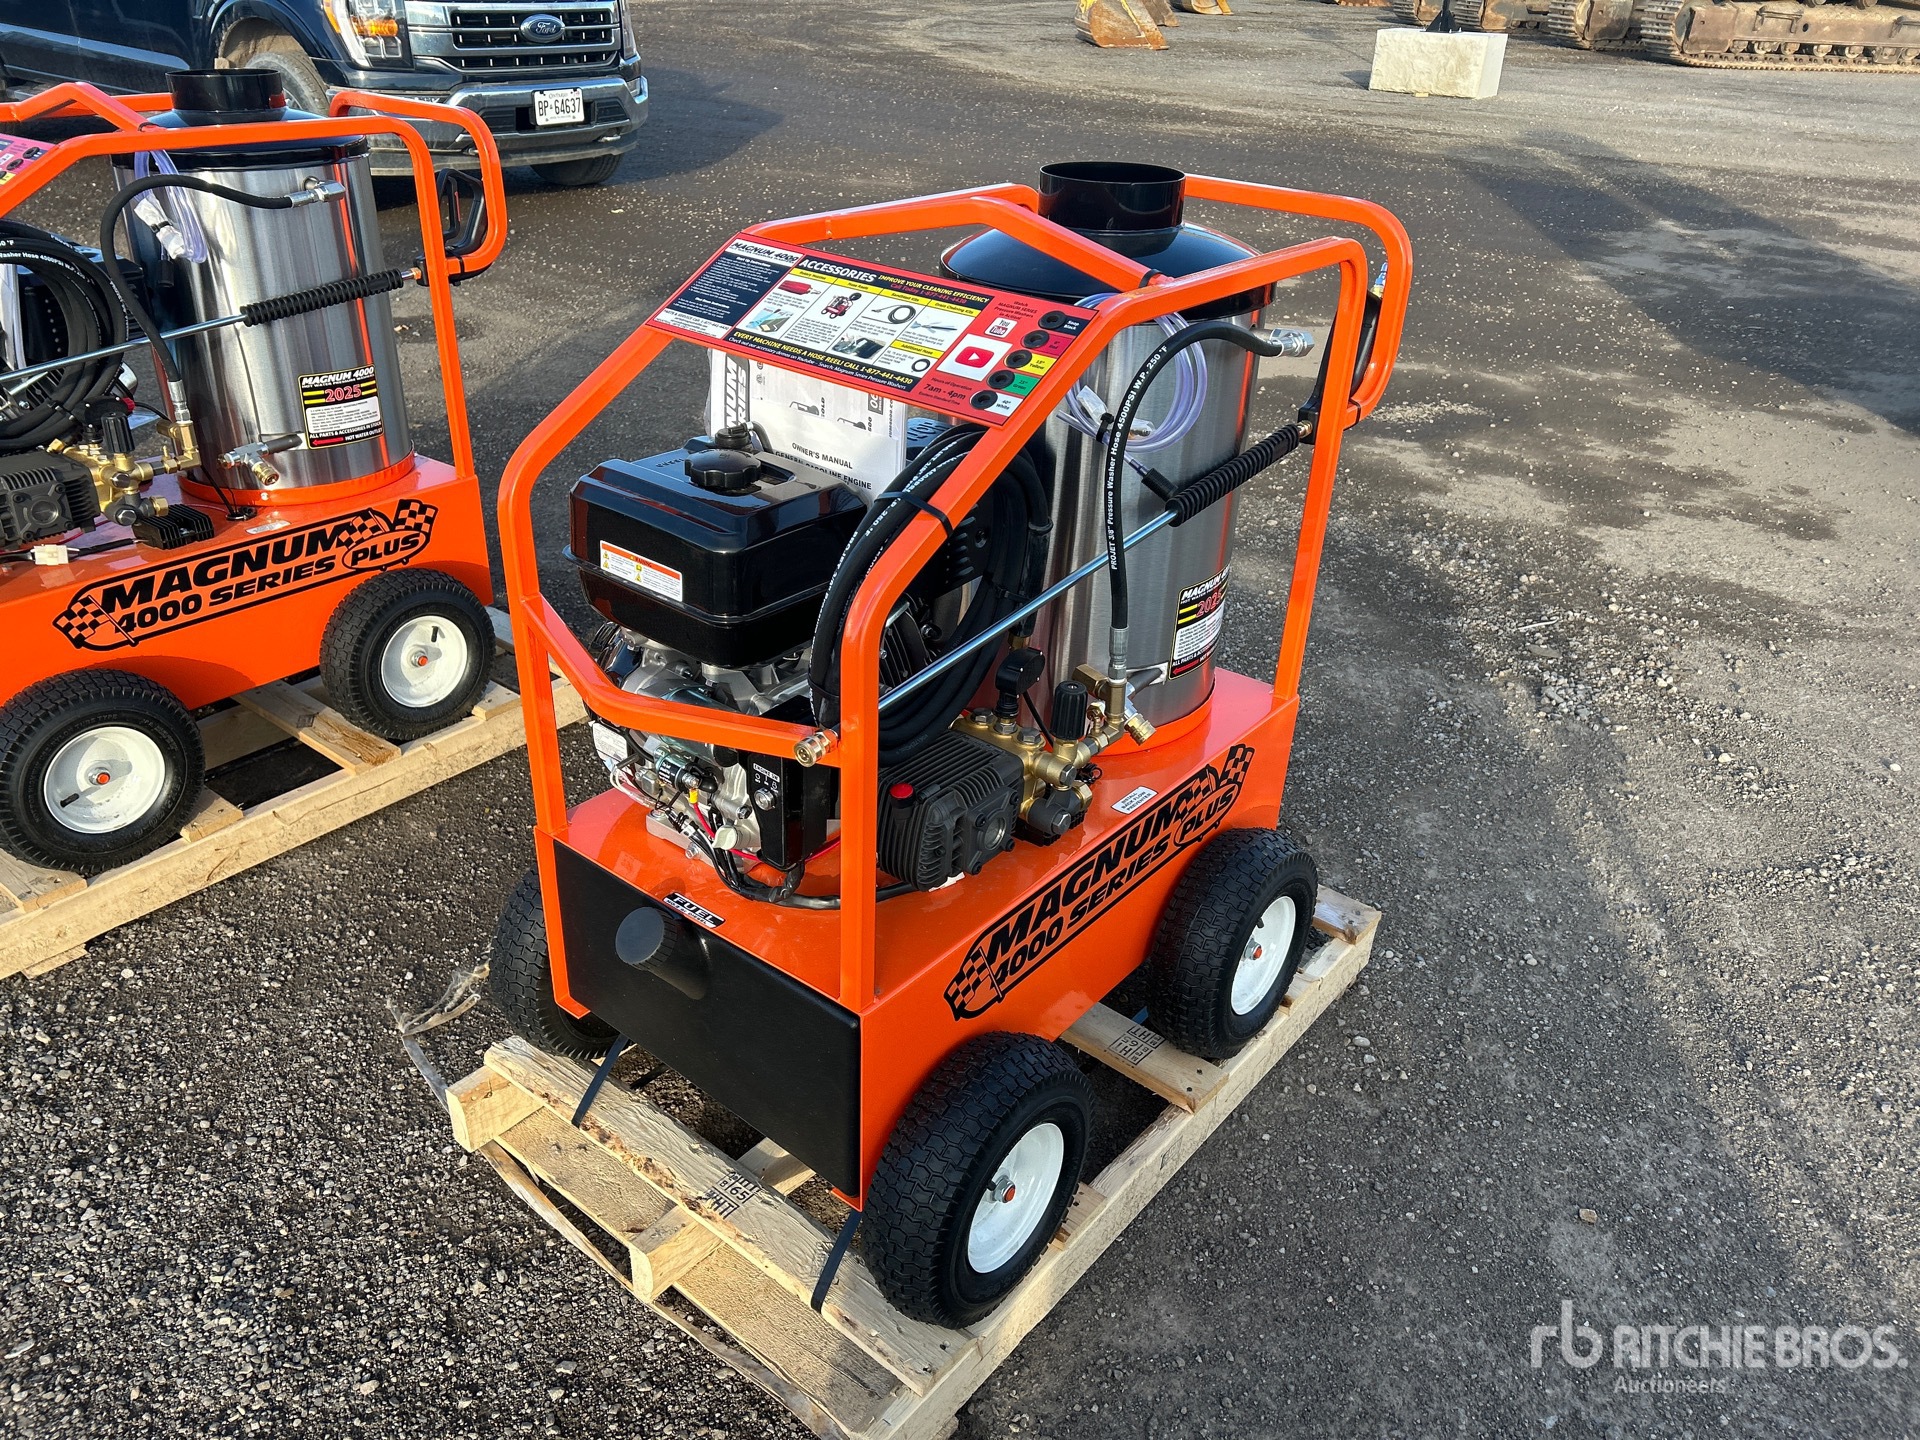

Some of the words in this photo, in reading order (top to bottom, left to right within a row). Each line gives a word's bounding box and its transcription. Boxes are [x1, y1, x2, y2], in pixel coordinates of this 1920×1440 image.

[536, 22, 556, 34] Ford
[538, 100, 548, 116] BP
[554, 97, 580, 115] 64637
[731, 242, 775, 256] MAGNUM
[775, 252, 800, 262] 4000
[799, 258, 878, 282] ACCESSORIES
[878, 274, 906, 285] IMPROVE
[906, 280, 922, 289] YOUR
[922, 284, 952, 296] CLEANING
[952, 290, 990, 303] EFFICIENCY
[999, 319, 1011, 327] You
[734, 331, 753, 340] EVERY
[753, 335, 782, 349] MACHINE
[781, 343, 803, 355] NEEDS
[807, 352, 826, 362] HOSE
[825, 356, 844, 366] REEL!
[844, 361, 860, 370] CALL
[901, 344, 922, 352] Additional
[302, 371, 352, 386] MAGNUM
[353, 366, 374, 377] 4000
[756, 345, 776, 355] accessory
[834, 366, 855, 376] Magnum
[855, 371, 868, 379] Series
[868, 375, 887, 385] Pressure
[887, 380, 907, 390] Washers
[325, 384, 362, 402] 2025
[726, 355, 738, 428] NUM
[924, 383, 942, 393] 7am
[947, 390, 966, 400] 4pm
[950, 382, 972, 390] Operation
[338, 425, 366, 435] ACCESSORIES
[1107, 460, 1116, 488] Washer
[1112, 431, 1122, 456] Hose
[1118, 390, 1138, 430] 4500PSI
[1133, 371, 1150, 389] W.P.
[1147, 354, 1160, 371] 250
[792, 442, 820, 459] OWNER'S
[822, 454, 853, 470] MANUAL
[843, 475, 872, 490] ENGINE
[836, 530, 858, 570] PROJET
[100, 524, 353, 614] MAGNUM
[114, 598, 204, 635] 4000
[208, 556, 337, 608] SERIES
[350, 534, 422, 569] PLUS
[1182, 573, 1220, 601] MAGNUM
[1121, 792, 1138, 804] INSTALL
[988, 794, 1188, 966] MAGNUM
[990, 916, 1066, 987] 4000
[1067, 833, 1172, 930] SERIES
[1181, 788, 1234, 840] PLUS
[673, 896, 714, 924] FUEL
[1121, 1036, 1139, 1046] 65
[730, 1186, 750, 1201] 65
